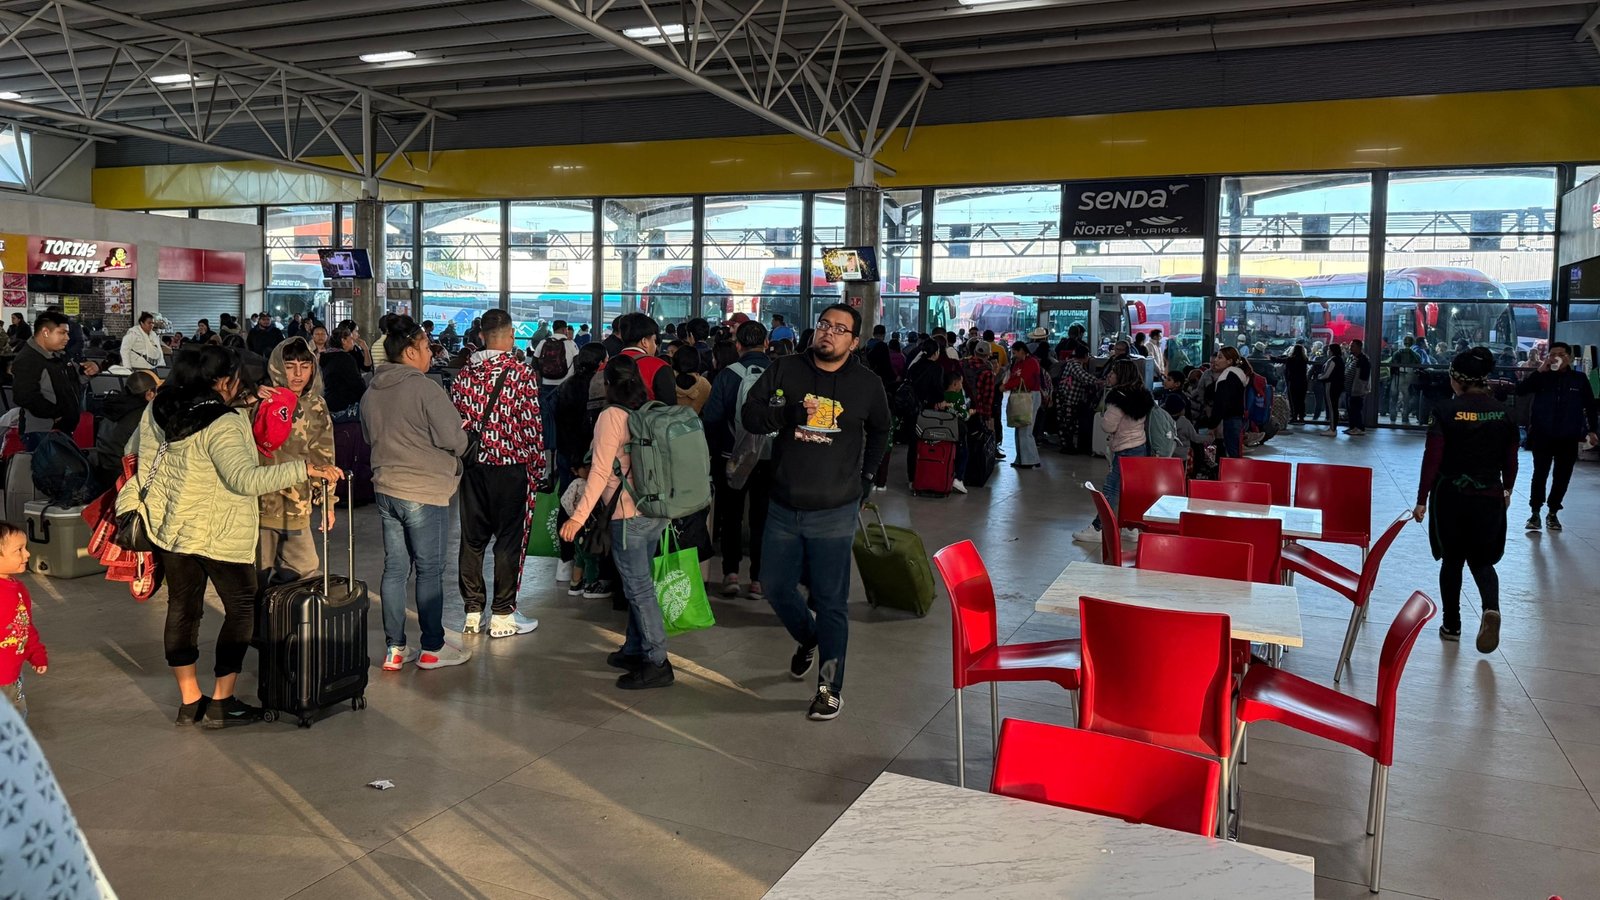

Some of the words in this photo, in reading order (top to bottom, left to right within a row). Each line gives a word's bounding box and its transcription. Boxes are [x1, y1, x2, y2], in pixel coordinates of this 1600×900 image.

[45, 239, 97, 258] TORTAS
[41, 261, 58, 271] DEL
[57, 258, 101, 274] PROFE
[1454, 411, 1505, 422] SUBWAY
